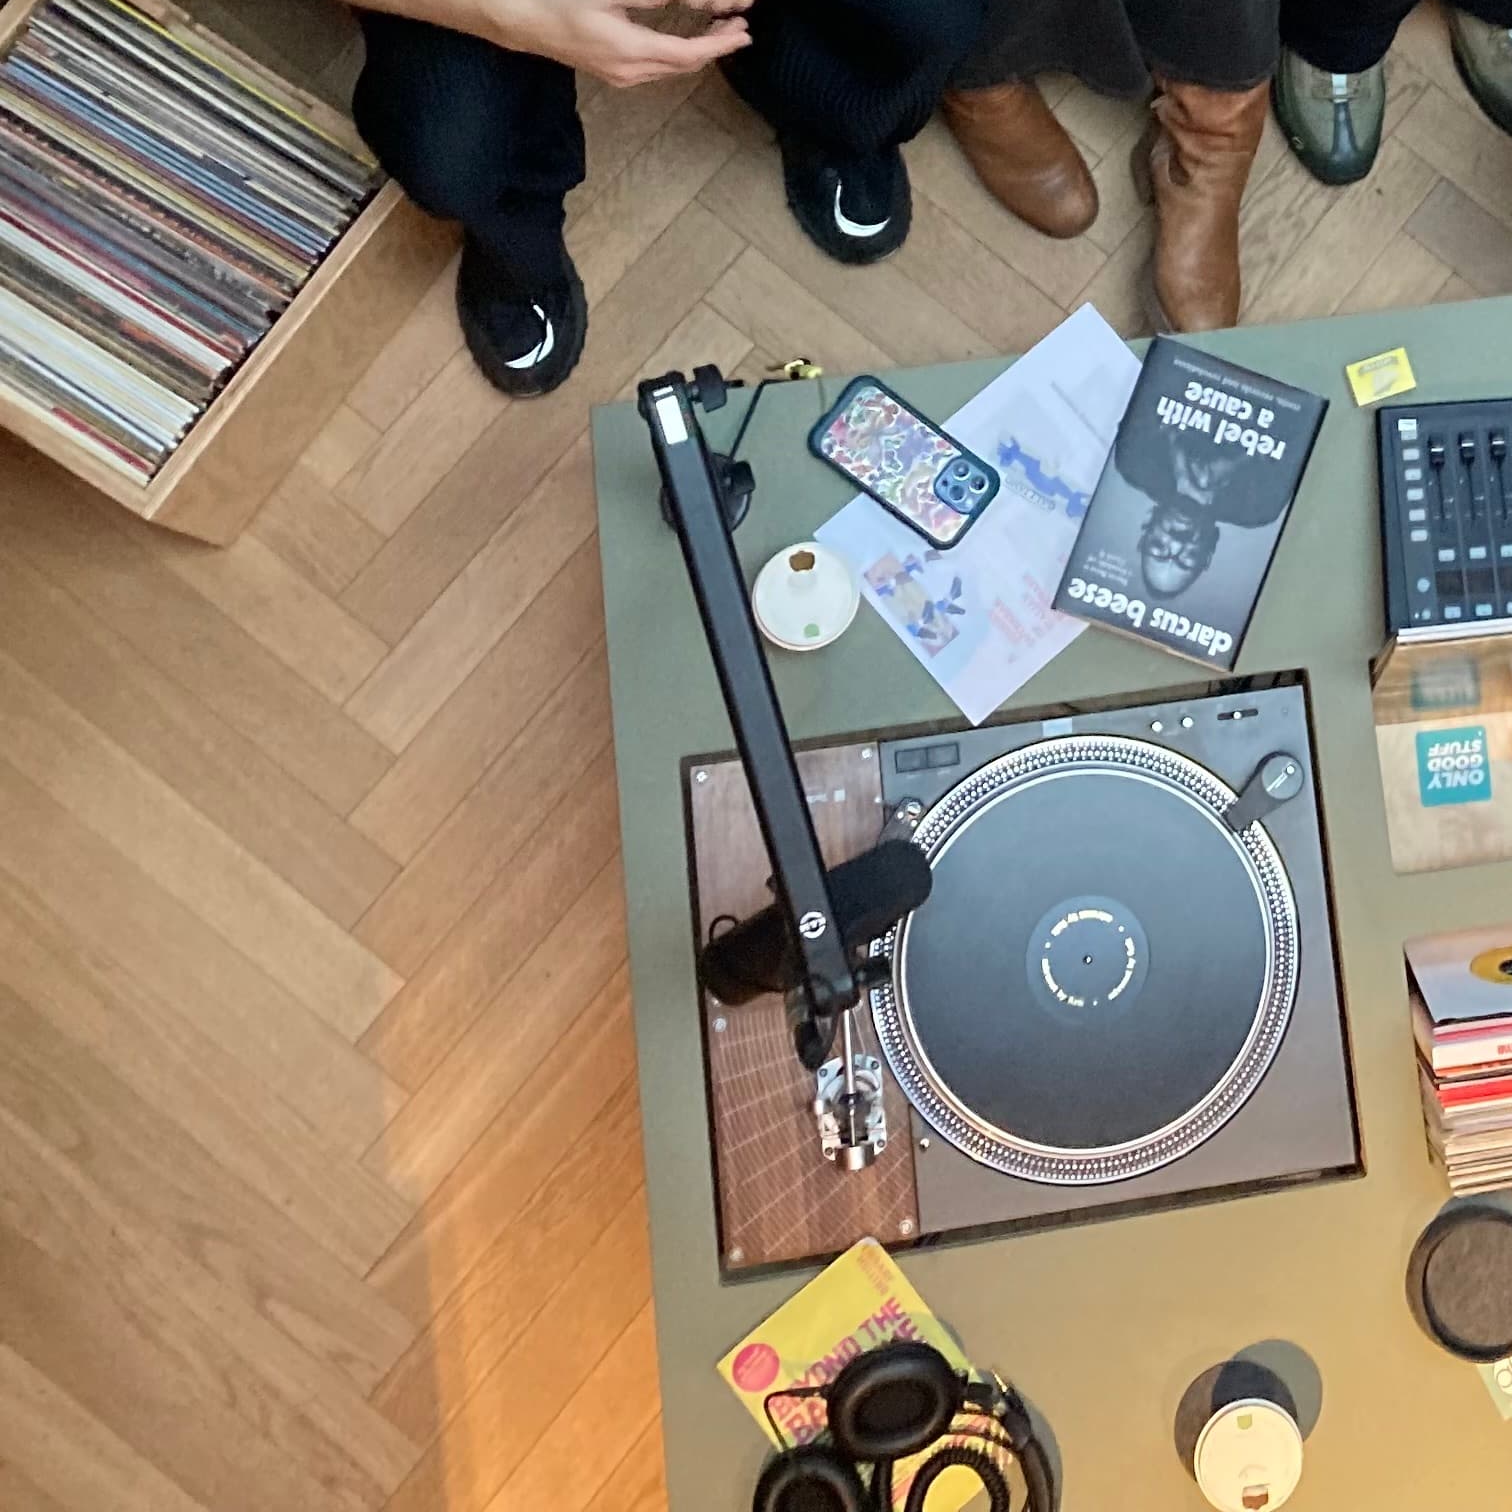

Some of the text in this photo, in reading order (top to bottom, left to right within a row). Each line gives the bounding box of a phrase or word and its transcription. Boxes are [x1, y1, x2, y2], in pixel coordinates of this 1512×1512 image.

[1156, 395, 1287, 461] rebel with
[1184, 380, 1275, 429] a cause
[1067, 577, 1146, 628] beese
[1150, 607, 1232, 656] darcus
[1427, 754, 1483, 772] GOOD
[1428, 739, 1482, 757] STUFF
[1427, 769, 1485, 790] ONLY
[857, 1296, 907, 1342] THE
